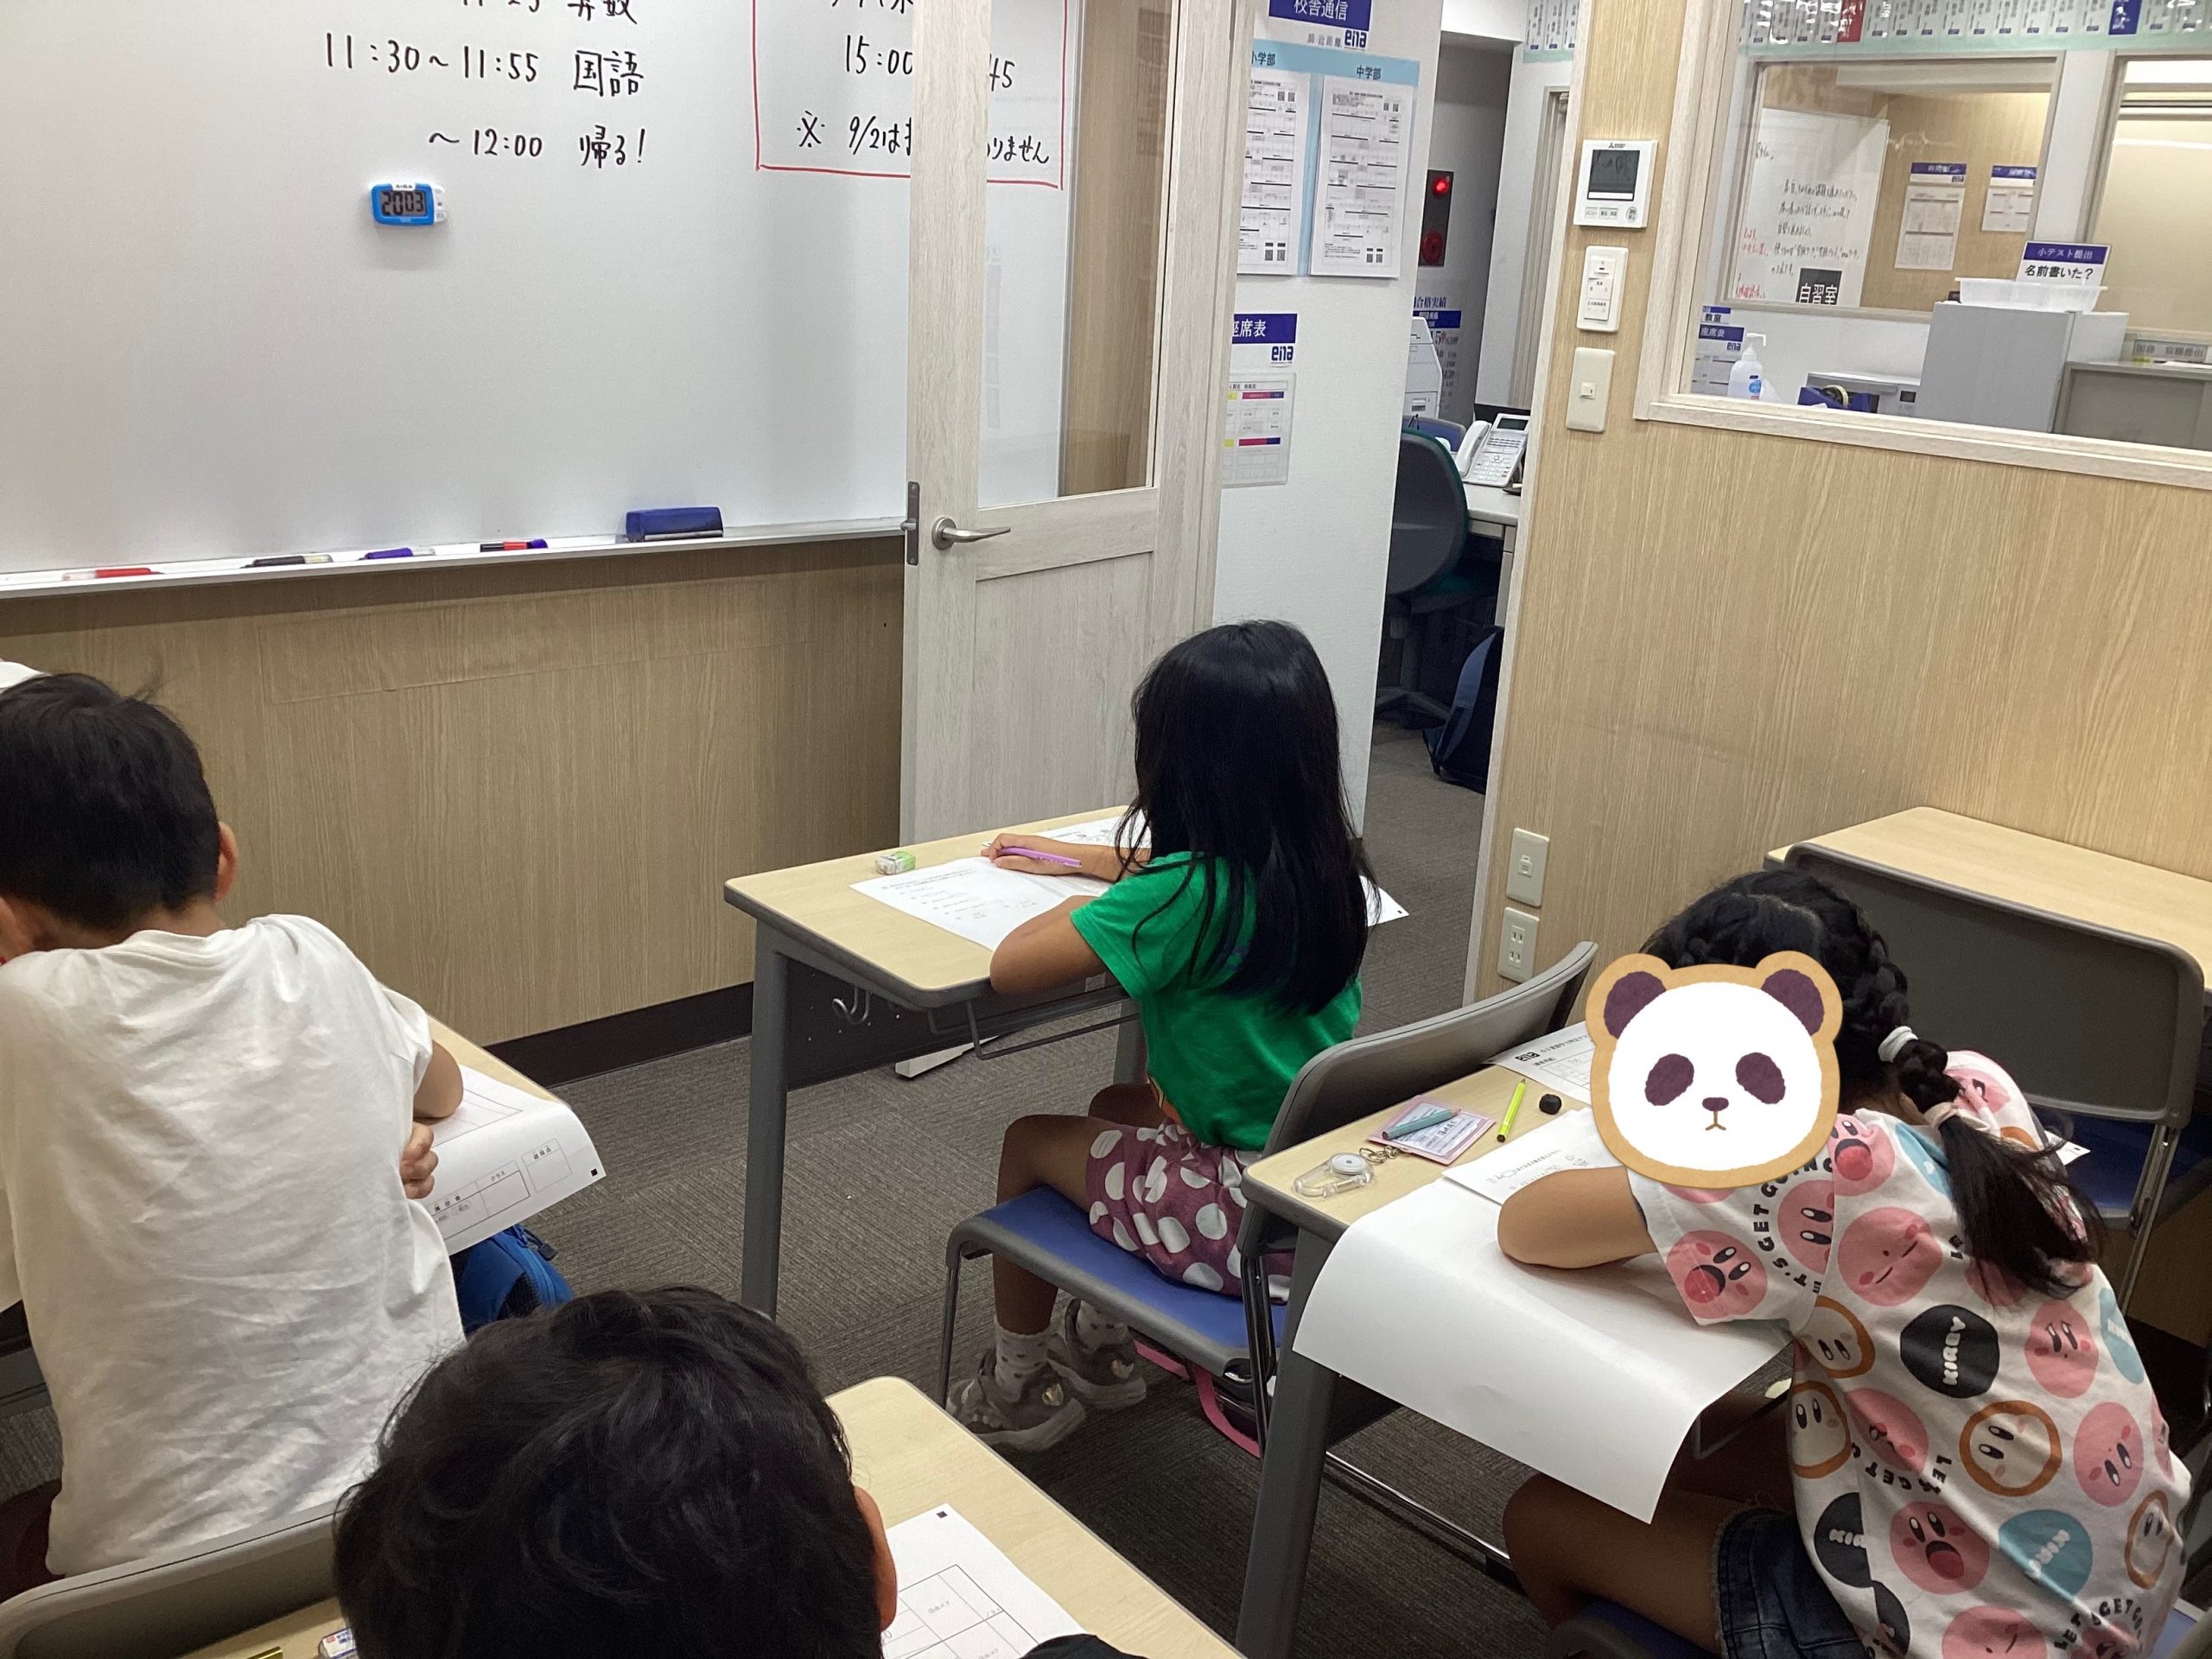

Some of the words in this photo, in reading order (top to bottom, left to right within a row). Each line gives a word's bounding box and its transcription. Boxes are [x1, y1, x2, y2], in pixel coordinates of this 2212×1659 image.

[1294, 0, 1349, 22] 校舎通信
[1344, 29, 1367, 48] ena
[573, 50, 645, 97] 国語
[1356, 65, 1382, 81] 中学部
[2024, 264, 2094, 280] 名前書いた？
[1797, 283, 1839, 305] 自習室
[1271, 346, 1294, 362] ena
[1726, 341, 1742, 351] ena
[1753, 1204, 1776, 1252] GET
